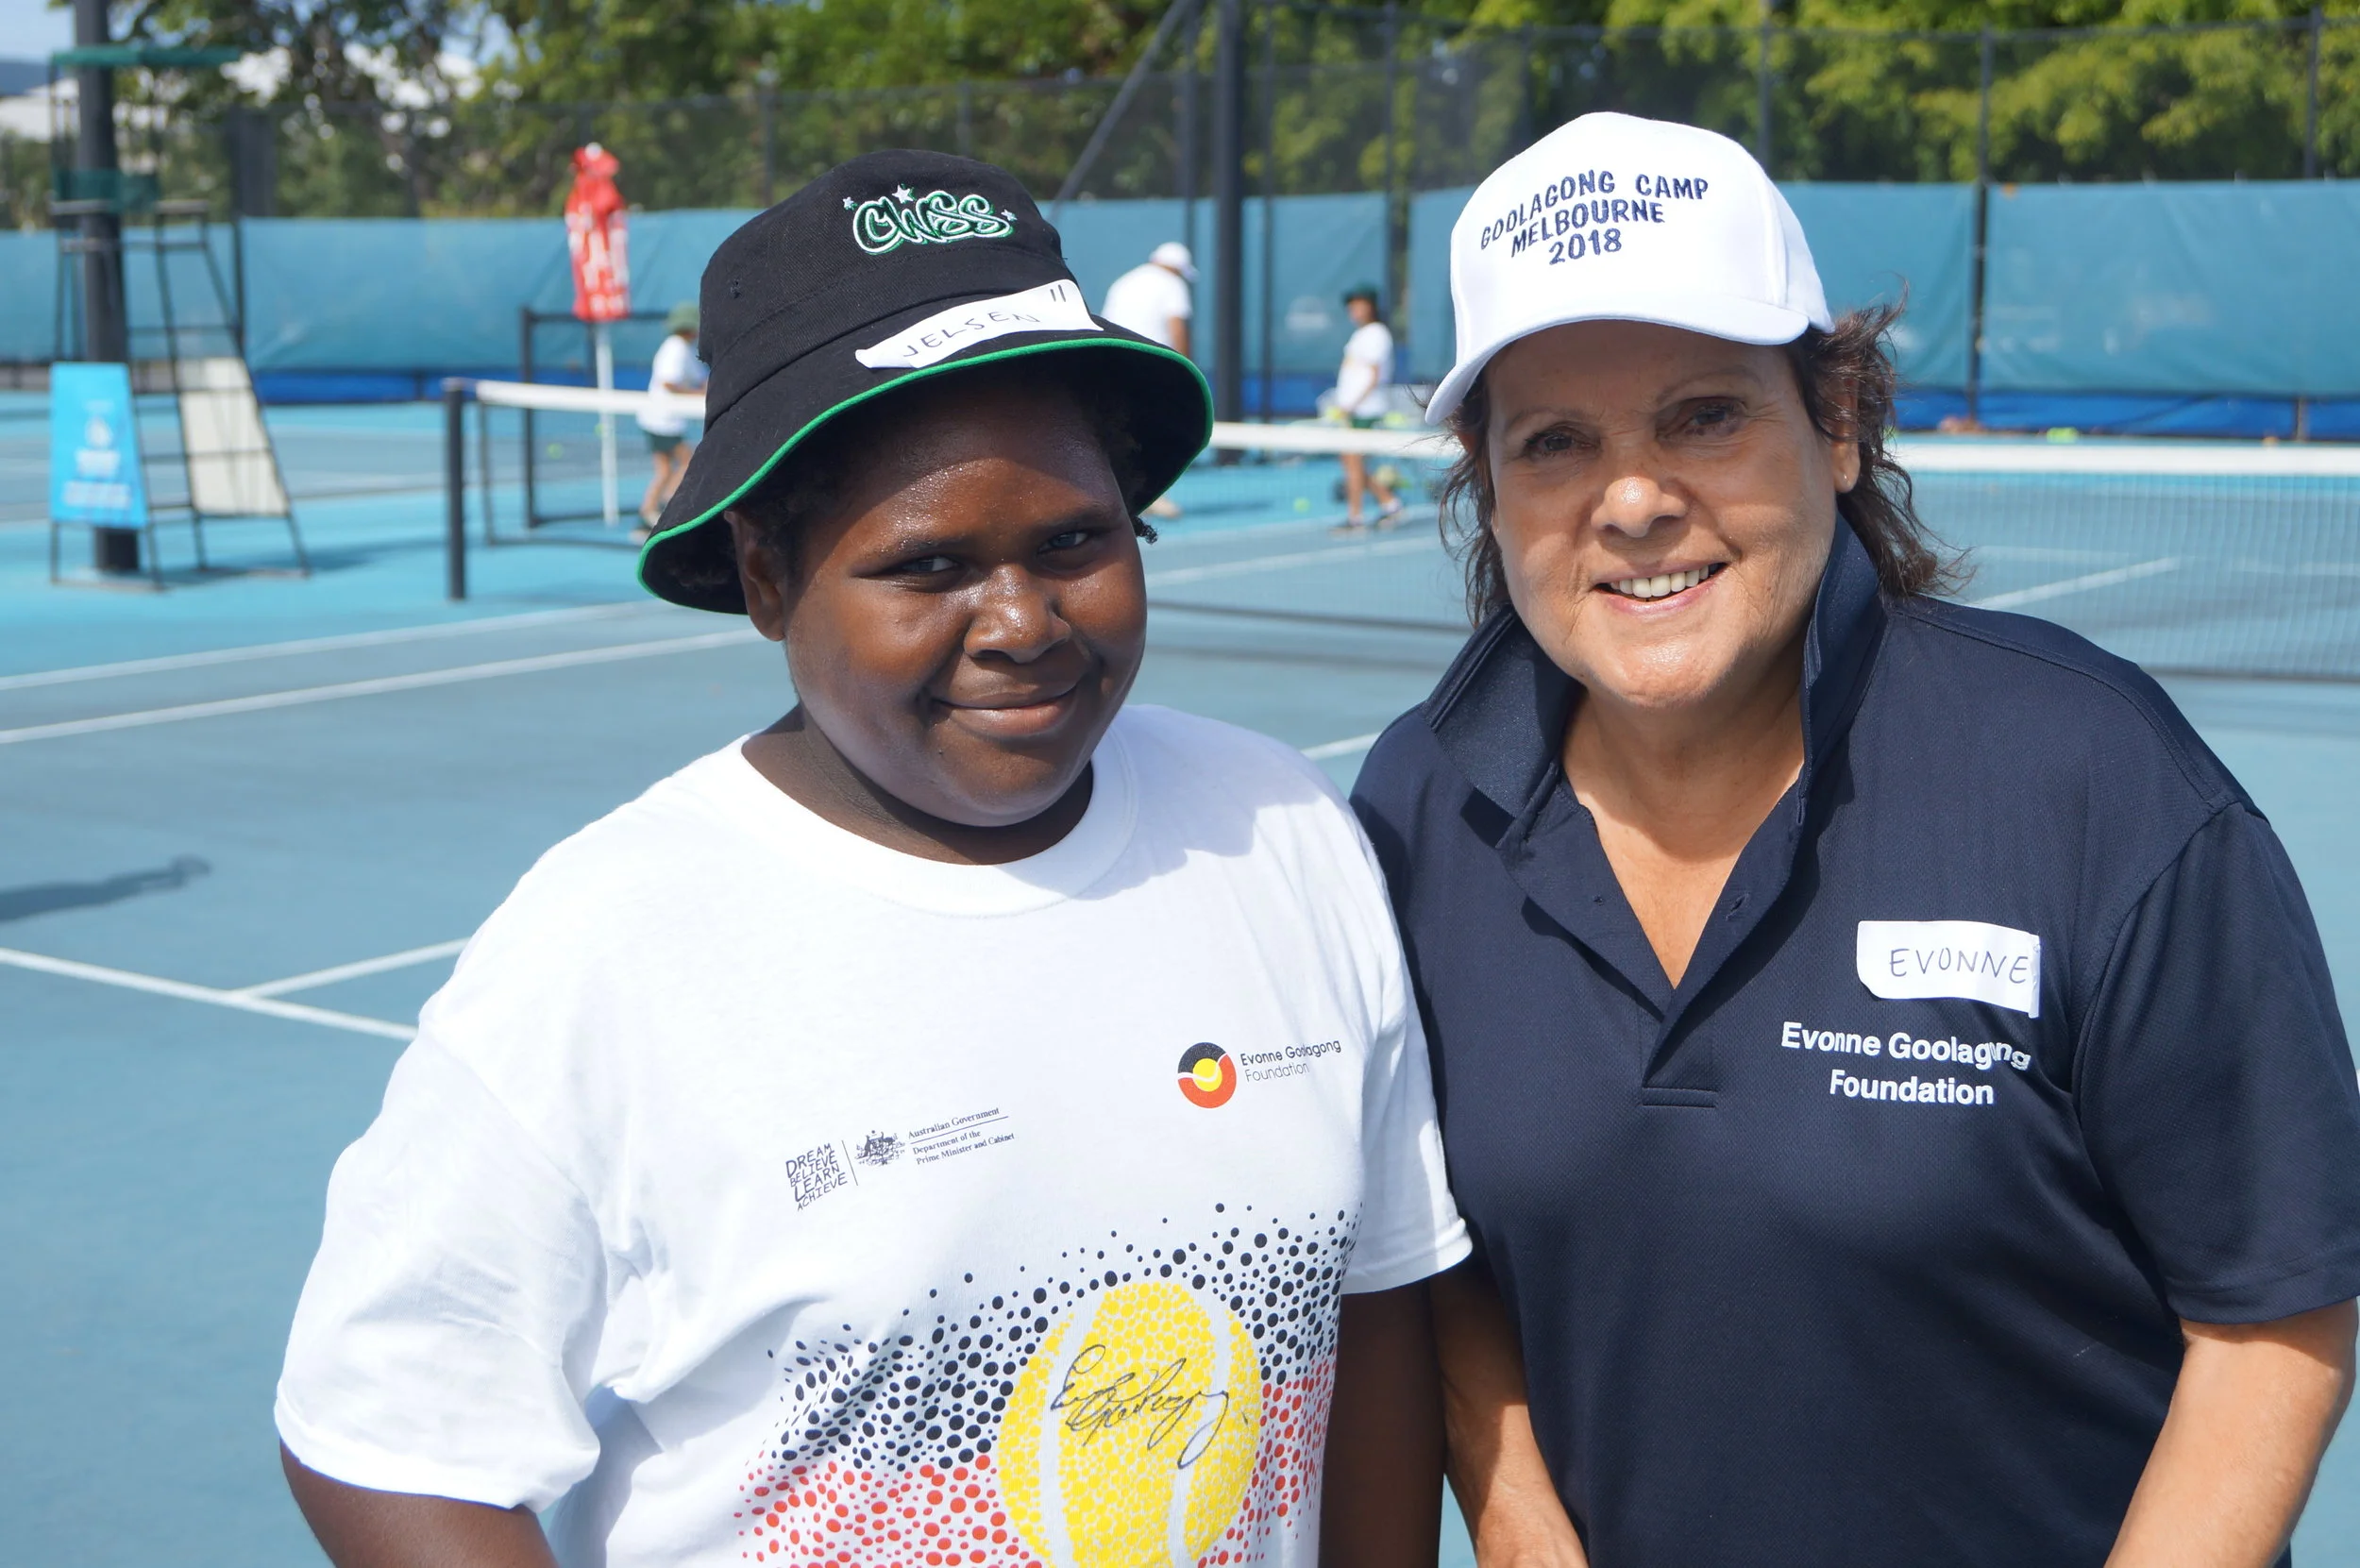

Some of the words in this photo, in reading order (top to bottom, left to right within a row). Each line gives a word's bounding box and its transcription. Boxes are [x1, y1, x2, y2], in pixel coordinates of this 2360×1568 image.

[1480, 169, 1616, 250] GOOLAGONG
[1635, 173, 1710, 200] CAMP
[1510, 198, 1665, 258] MELBOURNE
[1548, 228, 1623, 265] 2018
[902, 310, 1041, 357] JELSEN
[1889, 946, 2030, 985] EVONNE
[1781, 1021, 1881, 1056] Evonne
[1240, 1051, 1283, 1066] Evonne
[1244, 1062, 1310, 1083] Foundation
[1829, 1069, 1995, 1105] Foundation
[908, 1121, 952, 1139] Australian
[952, 1107, 1000, 1126] Government
[785, 1142, 833, 1178] DREAM
[913, 1137, 959, 1155] Department
[960, 1131, 969, 1141] of
[969, 1130, 982, 1139] the
[916, 1154, 940, 1166] Prime
[941, 1144, 972, 1158] Minister
[974, 1139, 987, 1149] and
[988, 1133, 1015, 1145] Cabinet
[789, 1150, 837, 1188] BELIEVE
[795, 1163, 839, 1202] LEARN
[797, 1172, 848, 1211] ACHIEVE
